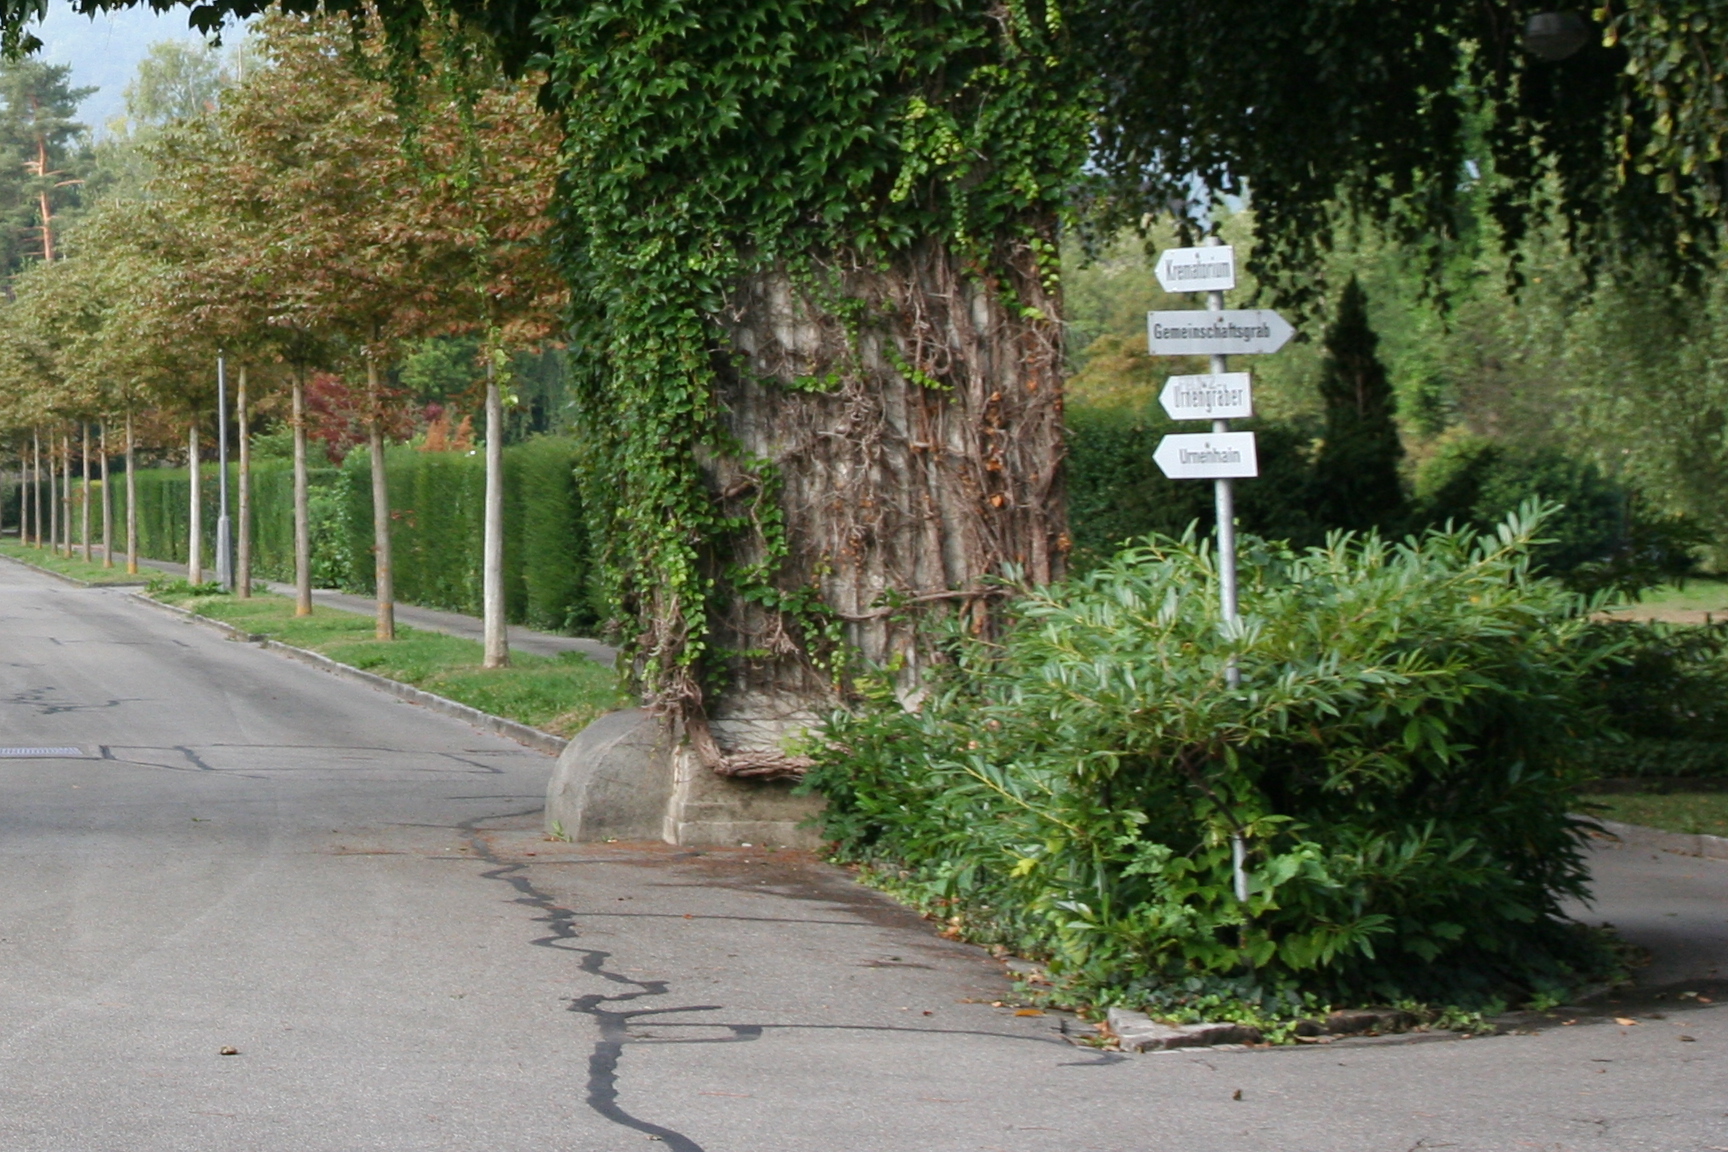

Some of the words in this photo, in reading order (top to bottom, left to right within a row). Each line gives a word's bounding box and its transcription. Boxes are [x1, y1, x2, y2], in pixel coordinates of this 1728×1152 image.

[1165, 257, 1230, 281] Krematorium
[1154, 322, 1270, 342] Gemeinschaftsgrab
[1173, 384, 1243, 413] Urnengräber
[1179, 447, 1241, 464] Urnenhain
